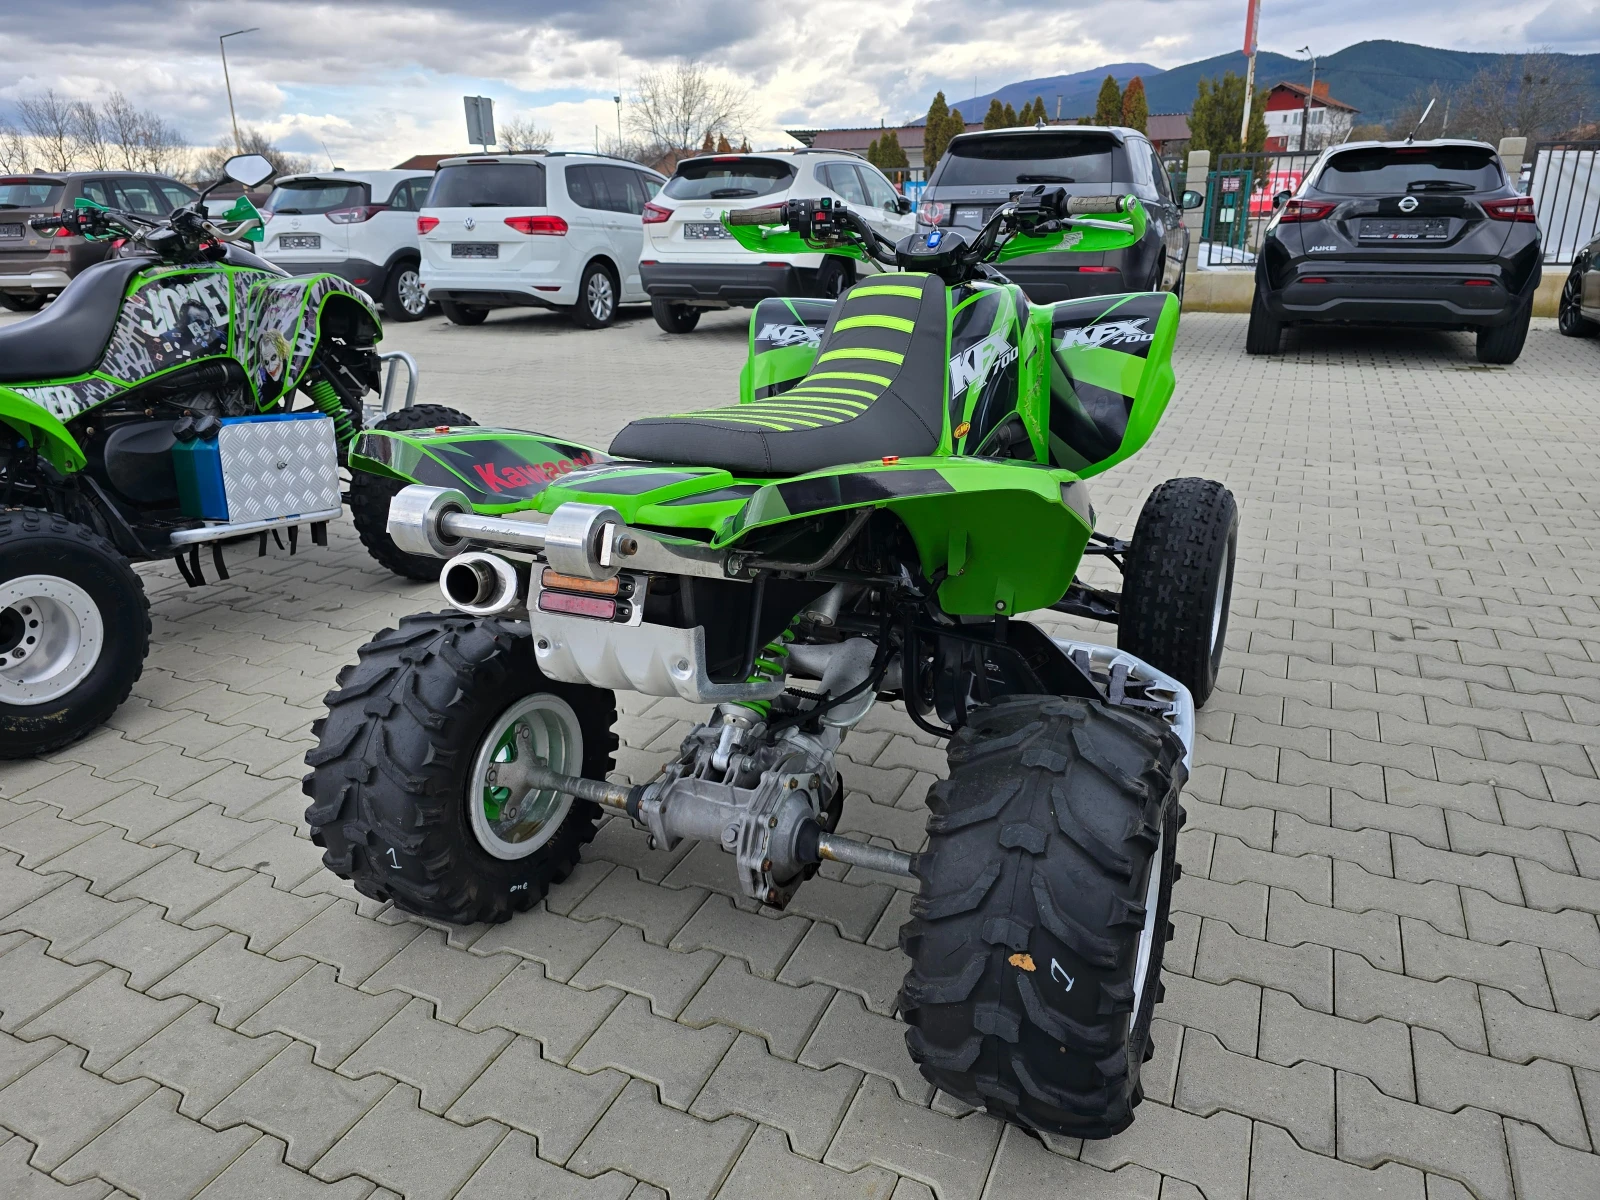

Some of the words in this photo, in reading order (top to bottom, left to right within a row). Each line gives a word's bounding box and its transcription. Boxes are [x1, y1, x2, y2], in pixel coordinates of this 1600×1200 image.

[1308, 245, 1338, 253] JUKE
[1055, 317, 1150, 352] KFX
[1111, 333, 1155, 346] 700
[949, 322, 1014, 400] KFX
[992, 346, 1019, 376] 700
[386, 847, 403, 870] 1
